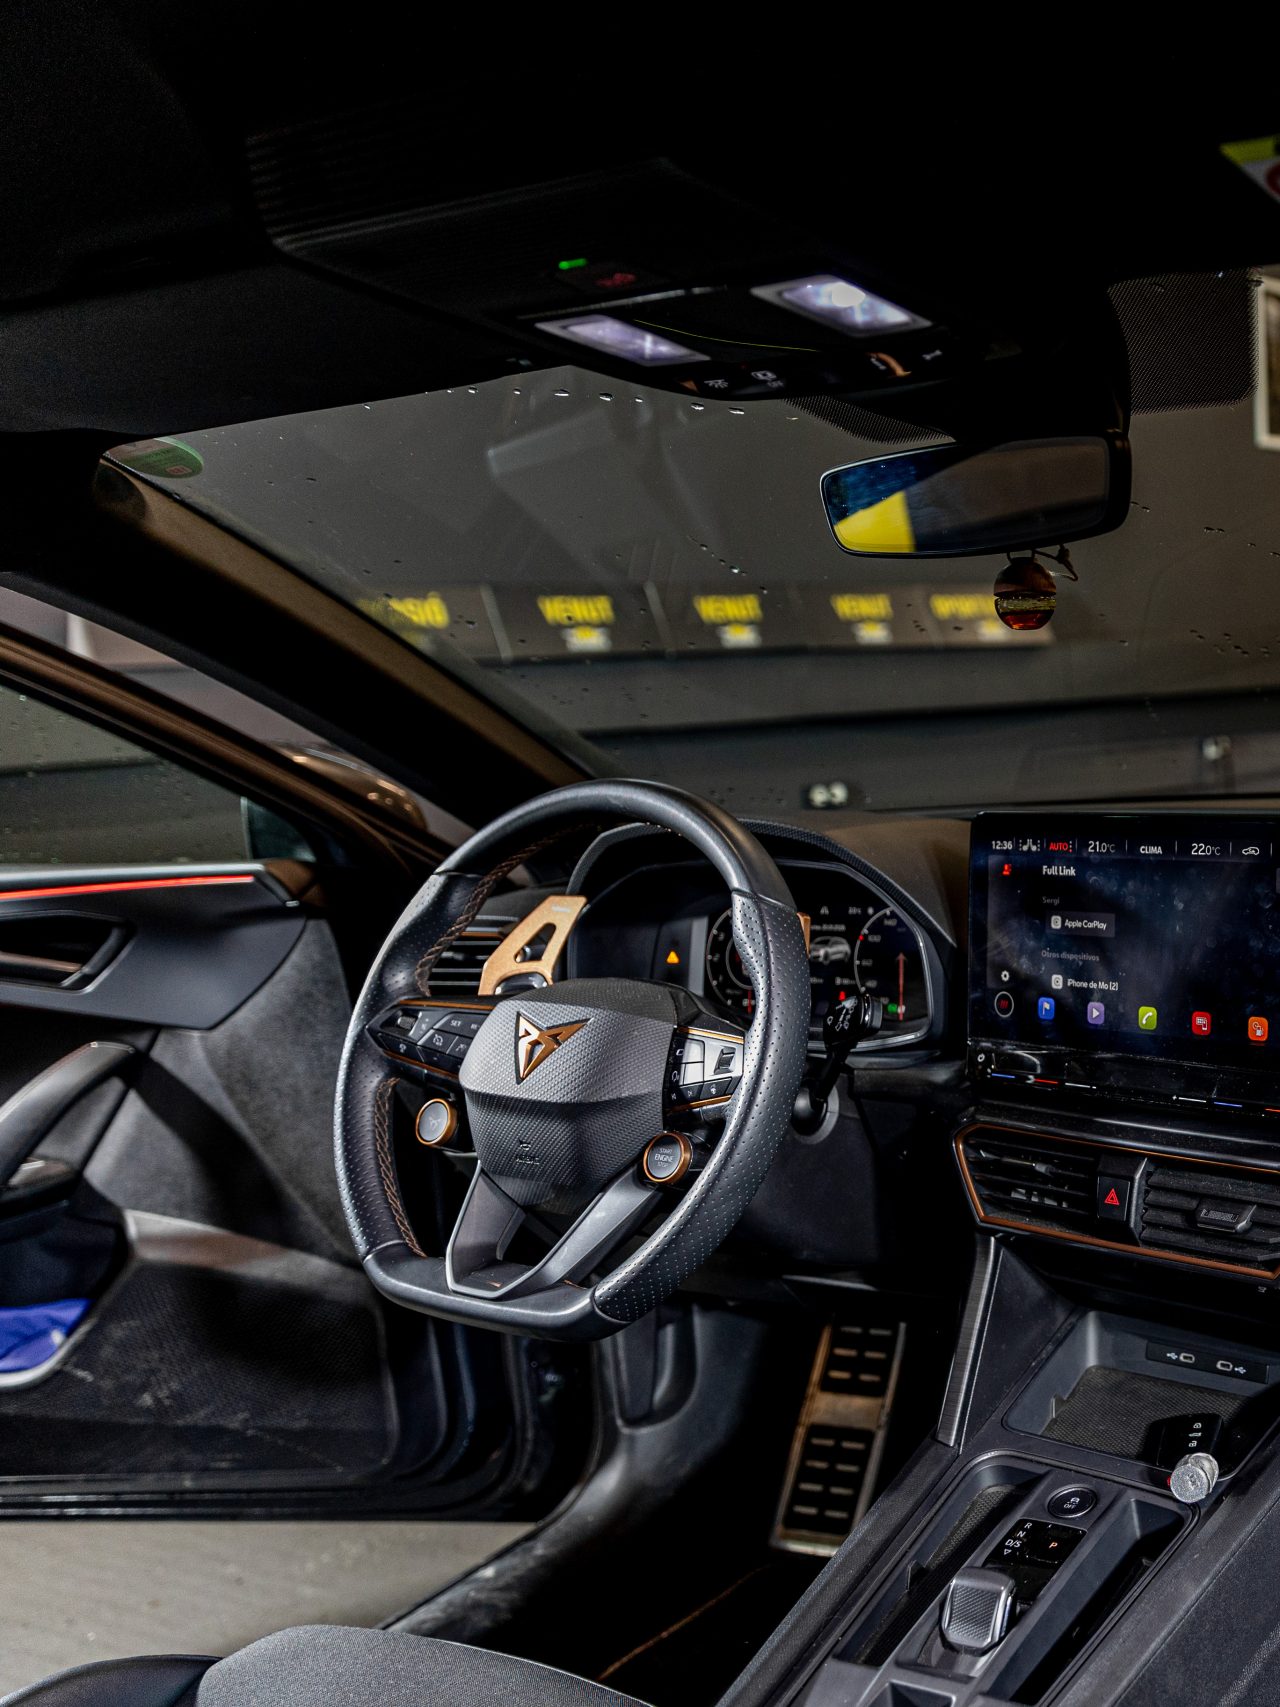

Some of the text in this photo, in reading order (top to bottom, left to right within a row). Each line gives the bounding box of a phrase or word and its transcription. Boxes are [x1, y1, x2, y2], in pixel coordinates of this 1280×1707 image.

[991, 840, 1013, 851] 12:36
[1049, 842, 1069, 852] AUTO
[1140, 845, 1163, 856] CLIMA
[1042, 865, 1077, 877] Full Link
[1042, 896, 1060, 906] Sergi
[1064, 918, 1107, 931] Apple CarPlay
[1060, 951, 1100, 963] dispositivos
[1067, 978, 1088, 989] iPhone
[1089, 980, 1098, 989] de
[1098, 981, 1109, 990] Mo
[451, 1020, 462, 1028] SET
[655, 1153, 674, 1162] ENGINE
[1004, 1539, 1022, 1548] D/S
[1048, 1541, 1058, 1549] P
